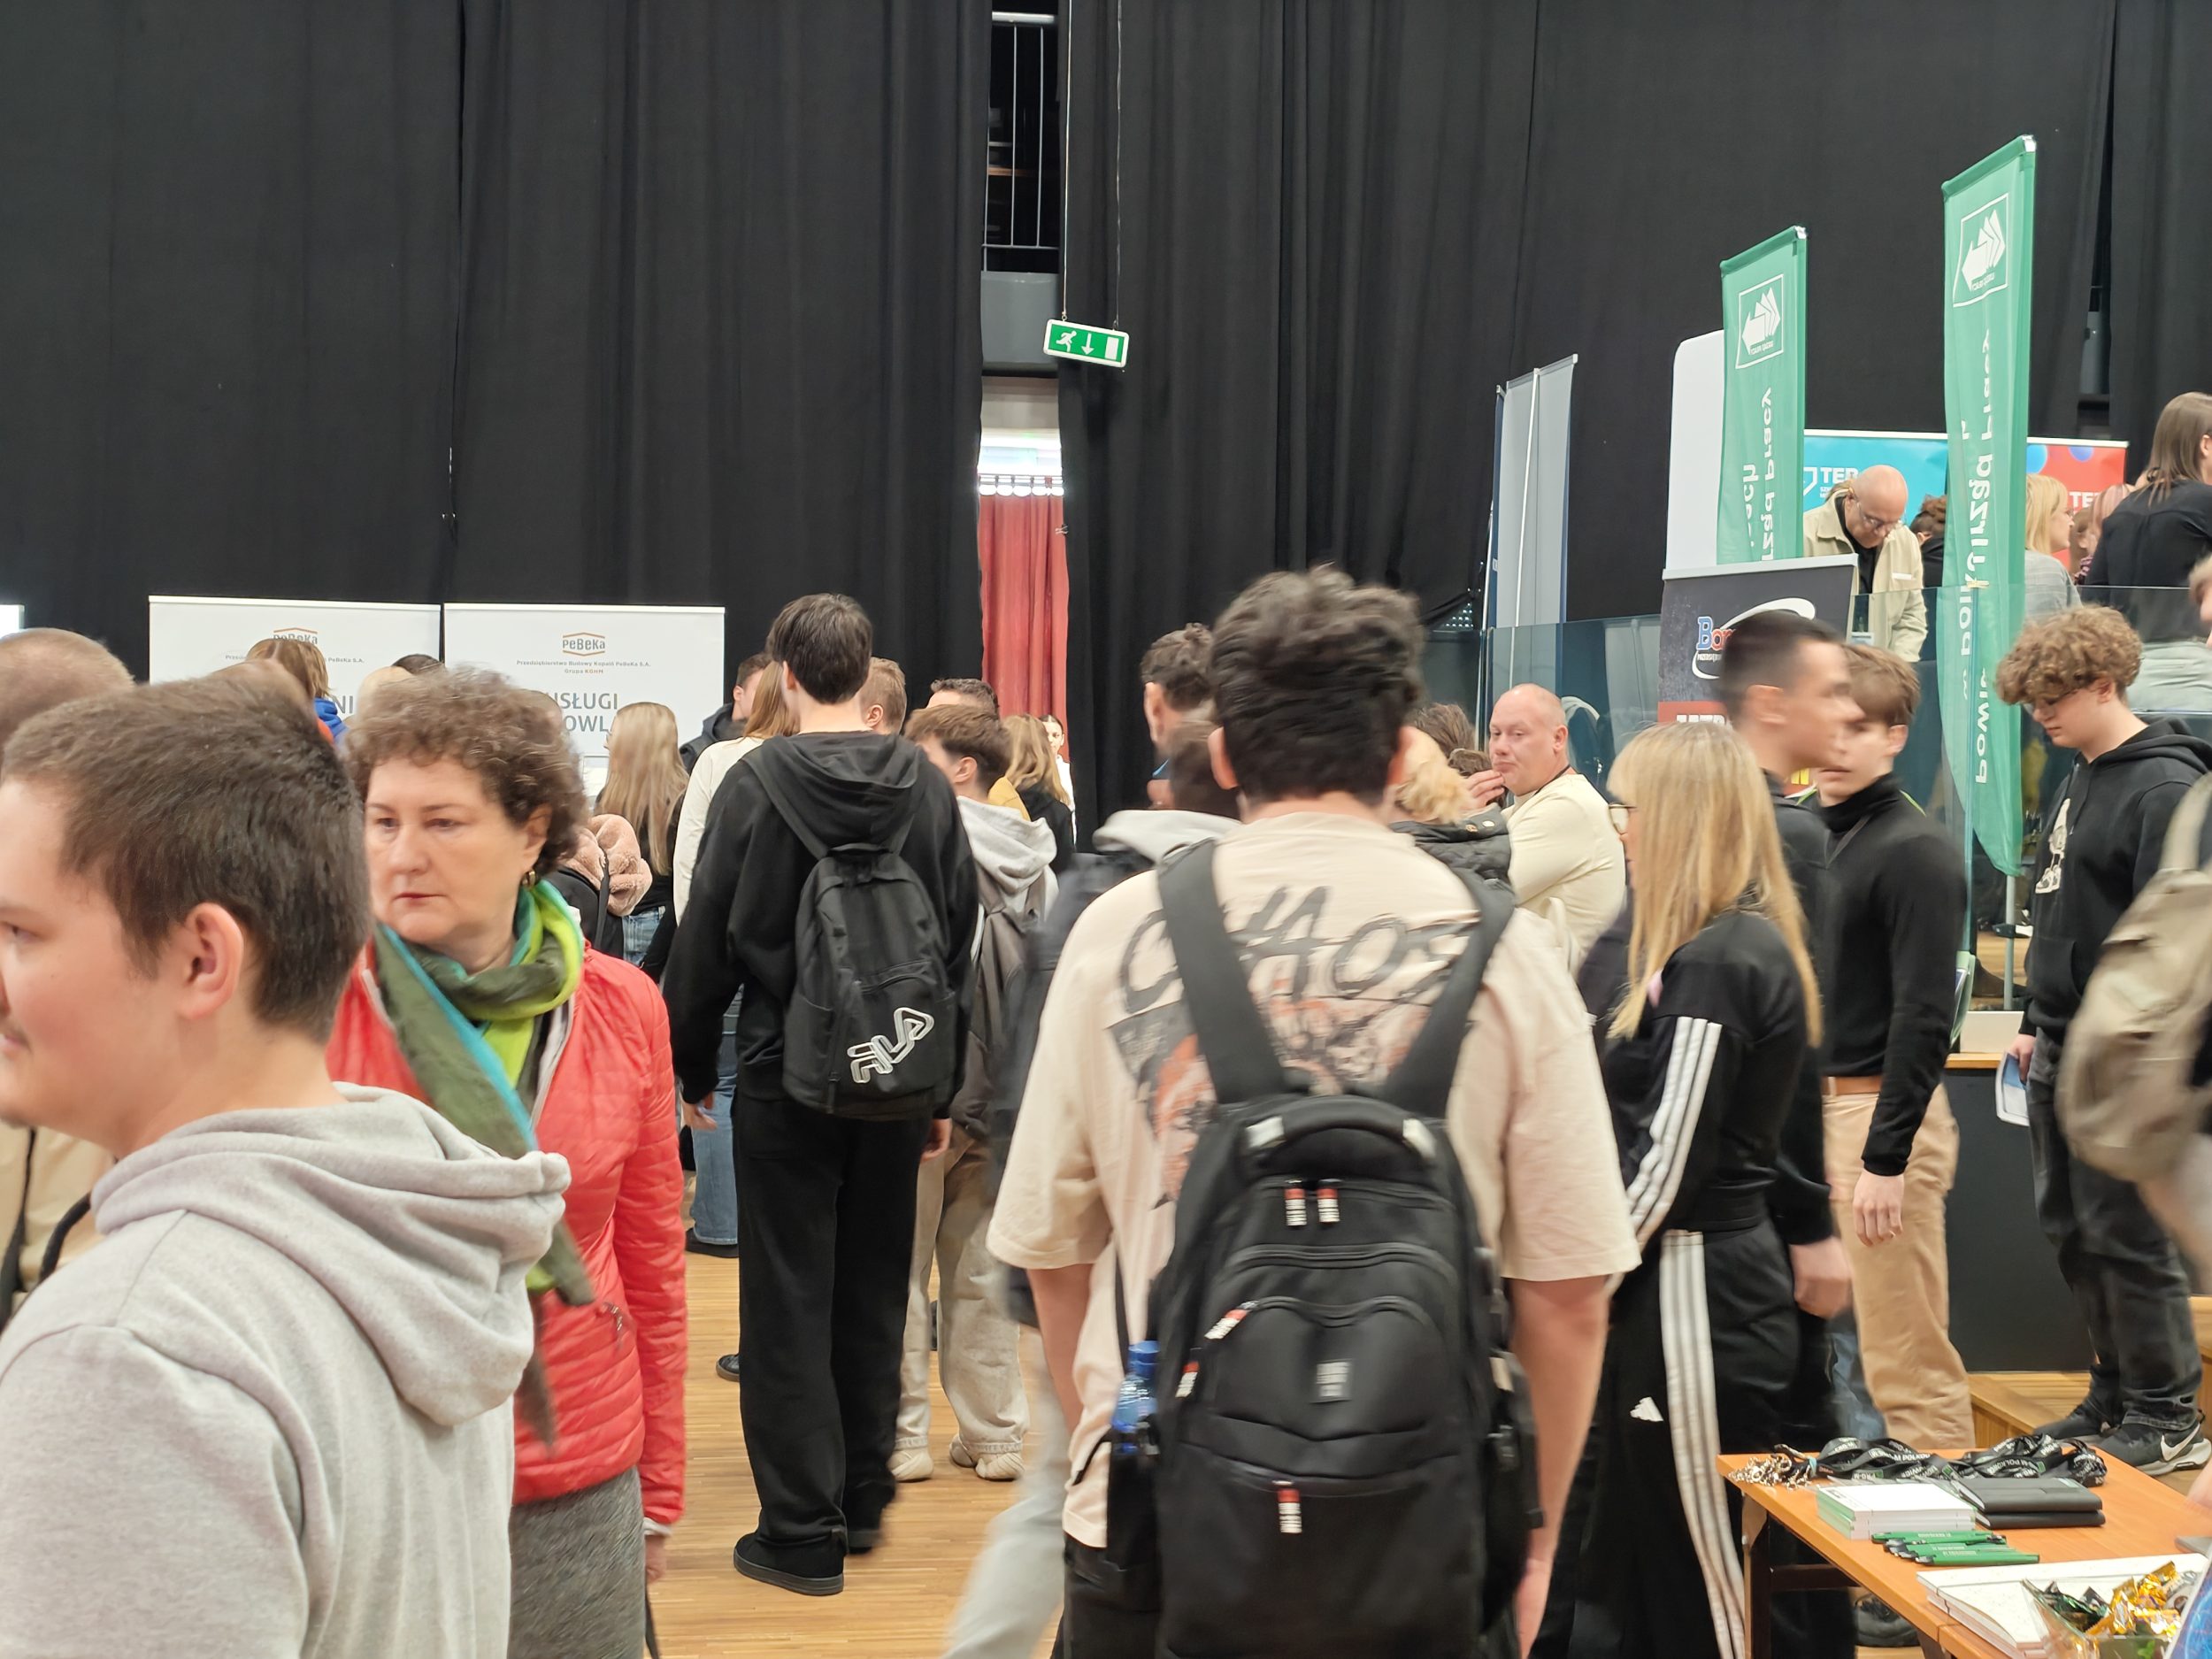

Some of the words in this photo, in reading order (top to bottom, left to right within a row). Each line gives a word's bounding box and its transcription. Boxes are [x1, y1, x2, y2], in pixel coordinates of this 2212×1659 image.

[2069, 491, 2101, 509] TE
[562, 639, 606, 650] PeBeKa
[563, 715, 610, 733] OWL
